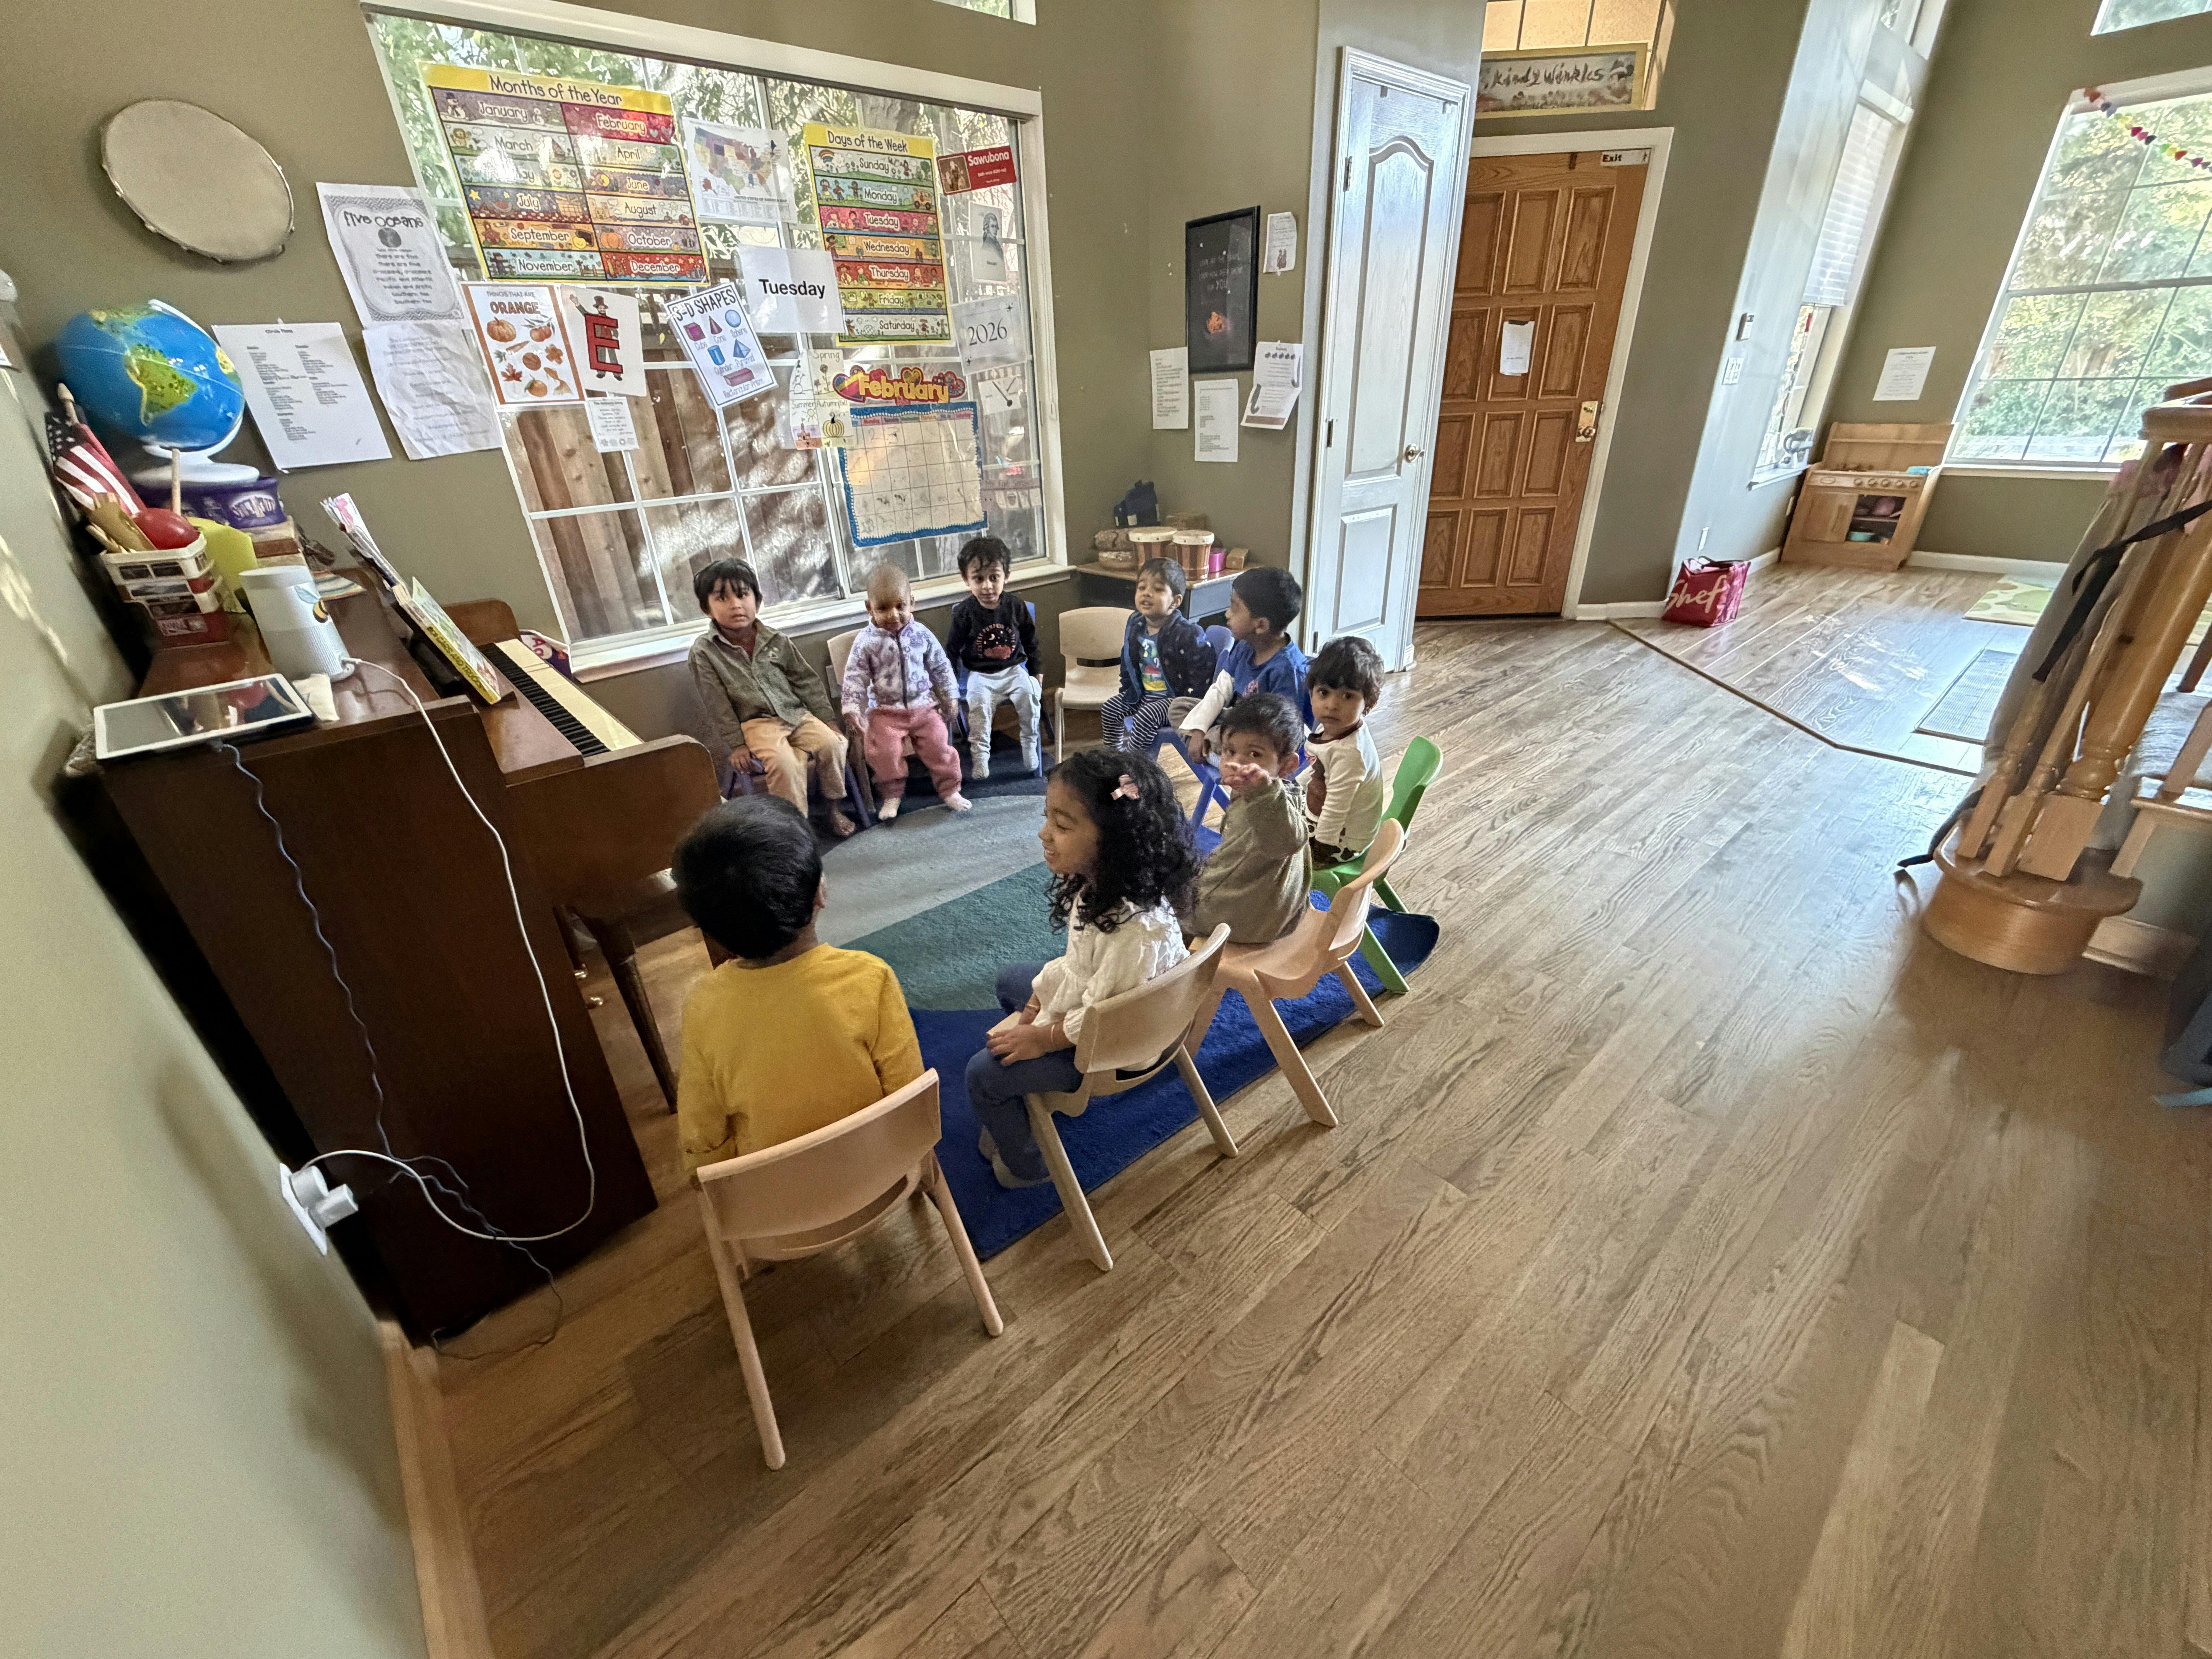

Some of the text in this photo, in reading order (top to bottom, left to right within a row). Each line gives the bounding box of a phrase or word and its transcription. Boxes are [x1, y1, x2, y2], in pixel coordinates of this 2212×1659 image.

[489, 76, 622, 105] Months of the Year
[480, 102, 527, 120] January
[597, 115, 646, 134] February
[495, 136, 533, 152] March
[828, 131, 907, 153] Days of the Week
[618, 146, 641, 162] April
[968, 151, 1010, 166] Sawubona
[859, 158, 889, 174] Sunday
[627, 177, 649, 191] June
[518, 192, 539, 211] July
[864, 188, 898, 204] Monday
[624, 202, 657, 218] August
[864, 214, 899, 229] Tuesday
[512, 227, 570, 244] September
[629, 234, 672, 247] October
[863, 242, 909, 256] Wednesday
[519, 258, 573, 272] November
[632, 261, 680, 274] December
[871, 267, 909, 281] Thursday
[759, 279, 825, 298] Tuesday
[490, 301, 541, 314] ORANGE
[694, 289, 736, 314] SHAPES
[878, 296, 904, 306] Friday
[879, 321, 915, 331] Saturday
[968, 318, 1008, 346] 2026
[812, 350, 840, 363] Spring
[857, 372, 949, 403] February
[792, 400, 815, 409] Summer
